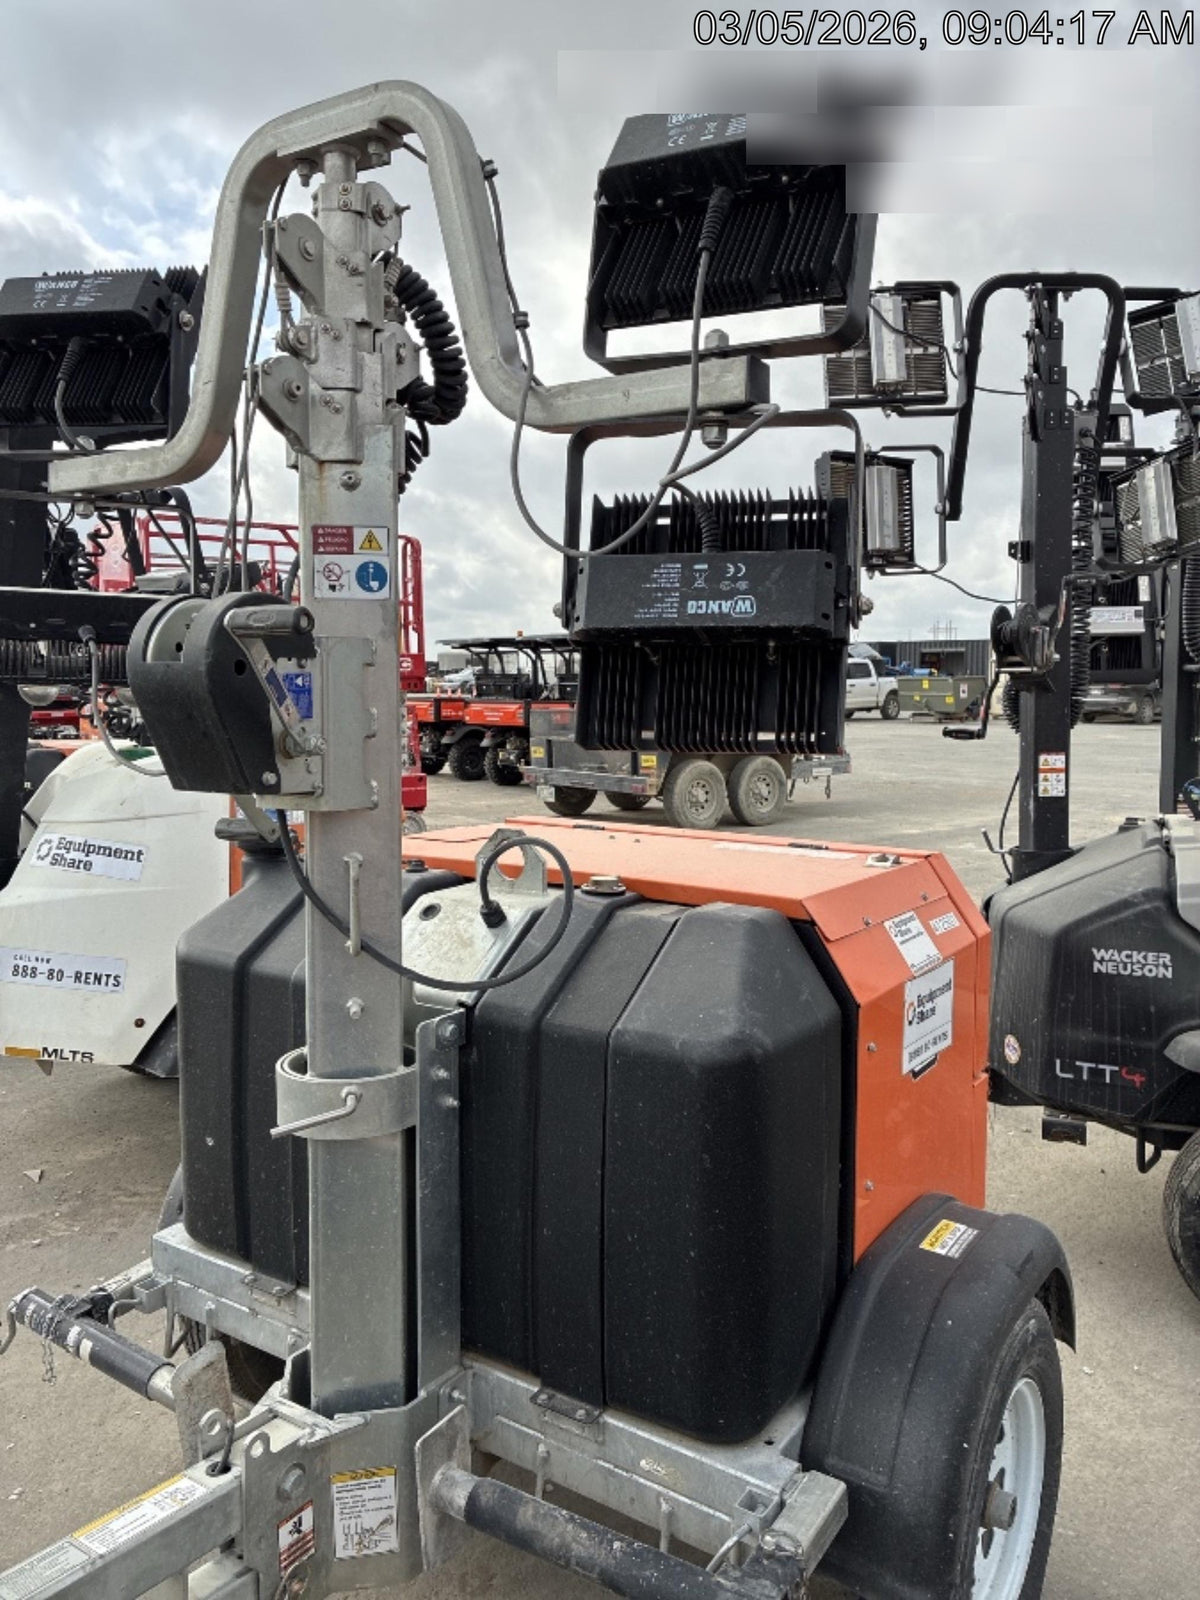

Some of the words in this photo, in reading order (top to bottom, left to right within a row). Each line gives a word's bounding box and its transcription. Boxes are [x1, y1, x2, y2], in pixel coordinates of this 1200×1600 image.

[687, 595, 757, 617] WANCO
[56, 837, 144, 863] Equipment
[49, 852, 94, 872] Share
[1092, 947, 1173, 966] WACKER
[11, 963, 121, 987] 888-80-RENTS
[1093, 961, 1173, 979] NEUSON
[917, 978, 952, 1007] Equipment
[1055, 1058, 1146, 1088] LTT4
